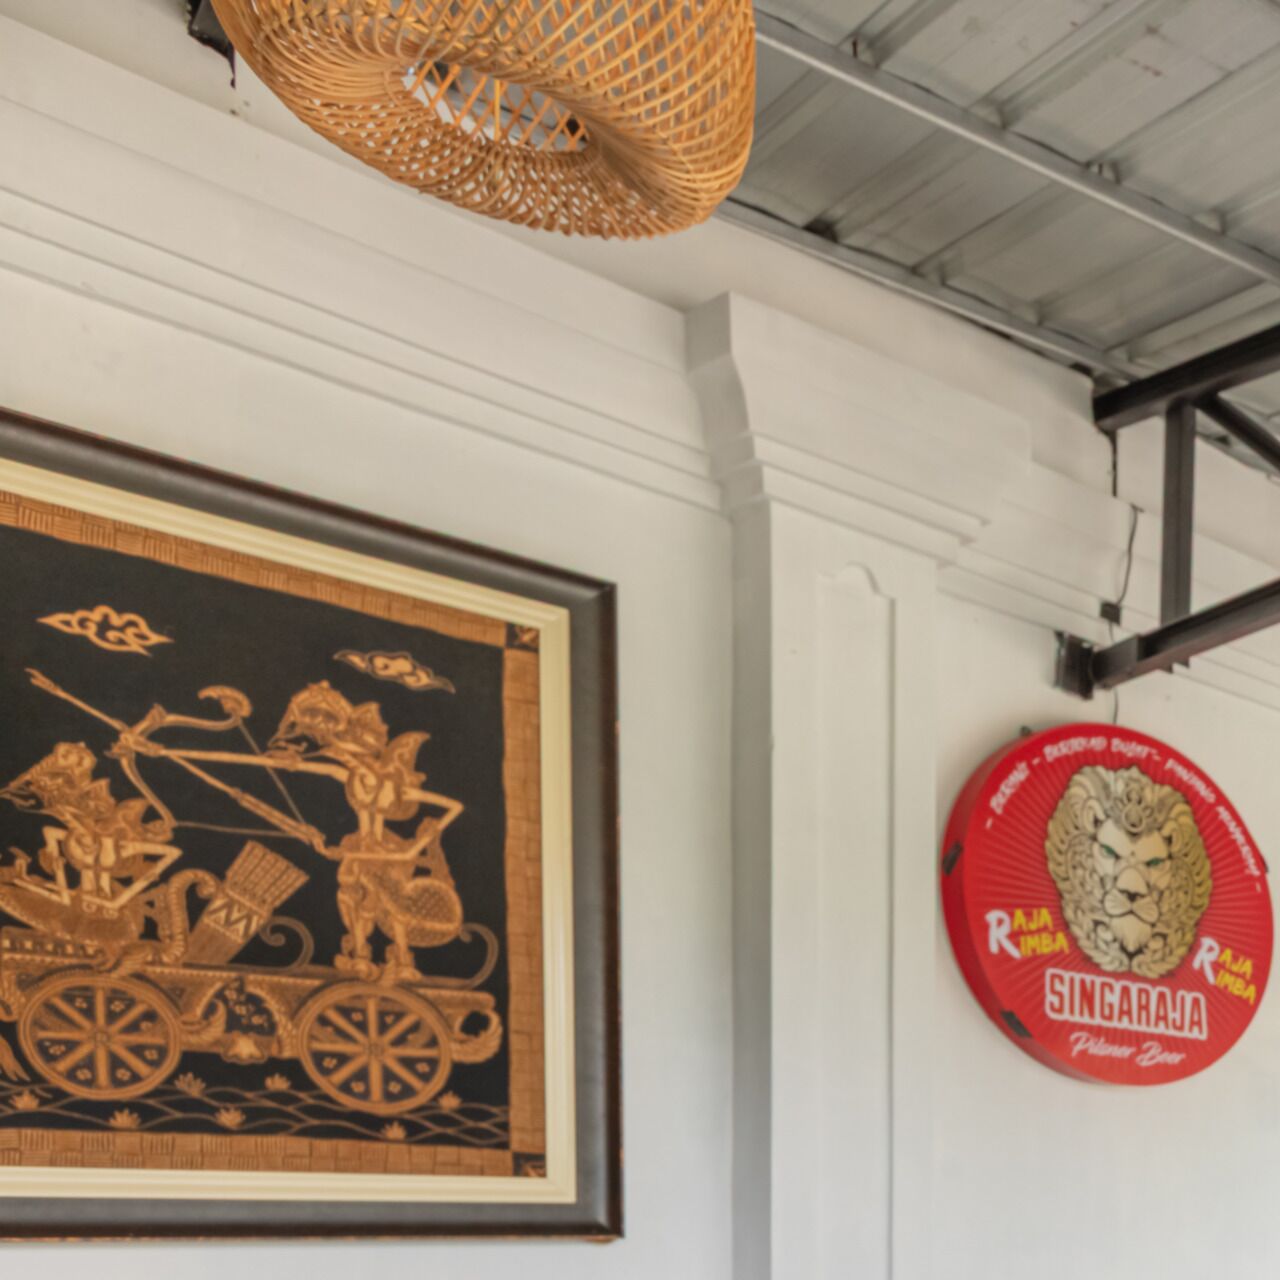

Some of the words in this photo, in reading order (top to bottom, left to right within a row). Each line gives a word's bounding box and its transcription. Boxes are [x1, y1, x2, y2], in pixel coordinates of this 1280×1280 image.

[1045, 968, 1207, 1040] SINGARAJA
[1069, 1031, 1135, 1060] Pilsner
[1136, 1041, 1186, 1067] Beer
